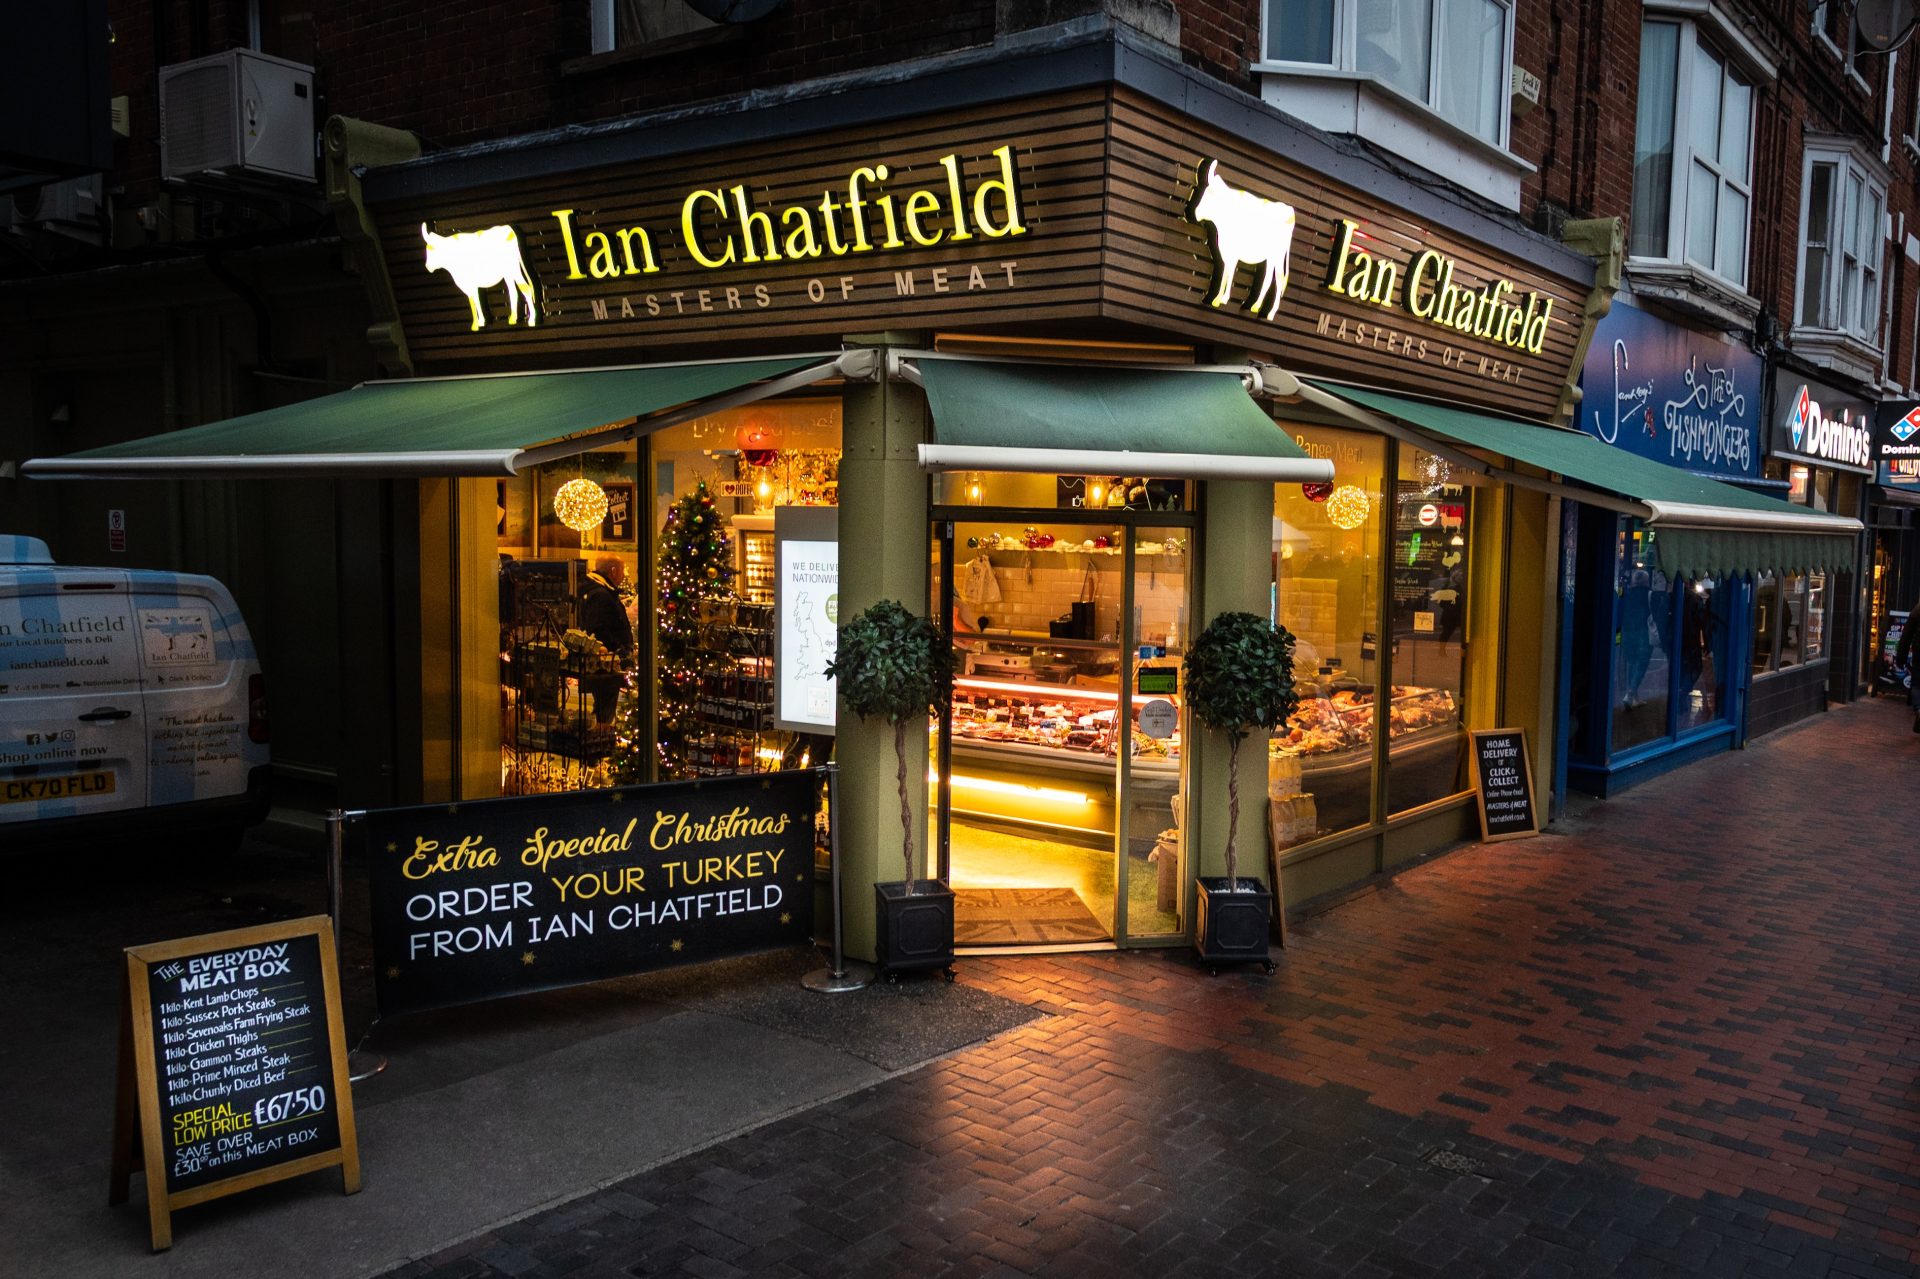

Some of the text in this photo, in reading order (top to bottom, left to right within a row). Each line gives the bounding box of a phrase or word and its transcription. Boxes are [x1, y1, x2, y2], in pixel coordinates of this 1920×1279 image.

[551, 145, 1026, 281] Ian Chatfield
[591, 261, 1018, 320] MASTERS OF MEAT
[1327, 218, 1553, 355] Ian Chatfield
[1316, 312, 1523, 384] MASTERS OF MEAT
[1664, 400, 1750, 472] FISHMONGERS
[1807, 400, 1870, 466] Domino's
[792, 561, 806, 570] WE
[22, 615, 125, 634] Chatfield
[43, 636, 83, 645] Butchers
[95, 635, 113, 643] Deli
[9, 656, 110, 670] ianchatfield.co.uk
[152, 651, 210, 662] Ian Chatfield
[83, 679, 122, 687] Nationwide
[123, 677, 149, 686] Delivery
[203, 714, 218, 723] has
[218, 713, 234, 722] been
[154, 727, 183, 740] nothing
[185, 728, 198, 737] but
[35, 747, 77, 760] online
[80, 745, 109, 756] now
[179, 742, 196, 751] look
[1483, 748, 1517, 759] DELIVERY
[1486, 739, 1511, 749] HOME
[162, 756, 194, 766] ordering
[196, 753, 218, 762] online
[1488, 776, 1519, 787] COLLECT
[1490, 767, 1511, 777] CLICK
[6, 774, 107, 800] CK70 FLD
[1487, 802, 1510, 810] MASTERS
[1513, 800, 1527, 808] MEAT
[402, 805, 791, 881] Extra Special Christmas
[406, 848, 786, 922] ORDER YOUR TURKEY
[410, 884, 783, 961] FROM IAN CHATFIELD
[154, 943, 288, 980] THE EVERYDAY
[180, 958, 291, 993] MEAT BOX
[206, 991, 230, 1006] Lamb
[230, 987, 259, 1001] Chops
[222, 1005, 245, 1017] Pork
[245, 997, 277, 1010] Steaks
[234, 1017, 256, 1029] Farm
[256, 1010, 283, 1026] Frying
[284, 1004, 311, 1018] Steak
[226, 1031, 259, 1046] Thighs
[235, 1044, 268, 1061] Steaks
[223, 1060, 258, 1078] Minced
[262, 1053, 291, 1069] Steak
[234, 1076, 261, 1091] Diced
[264, 1068, 287, 1084] Beef
[173, 1101, 237, 1131] SPECIAL
[174, 1112, 253, 1146] LOW PRICE
[176, 1131, 253, 1162] SAVE OVER
[208, 1156, 221, 1167] on
[223, 1149, 242, 1164] this
[247, 1136, 284, 1157] MEAT
[288, 1127, 319, 1146] BOX
